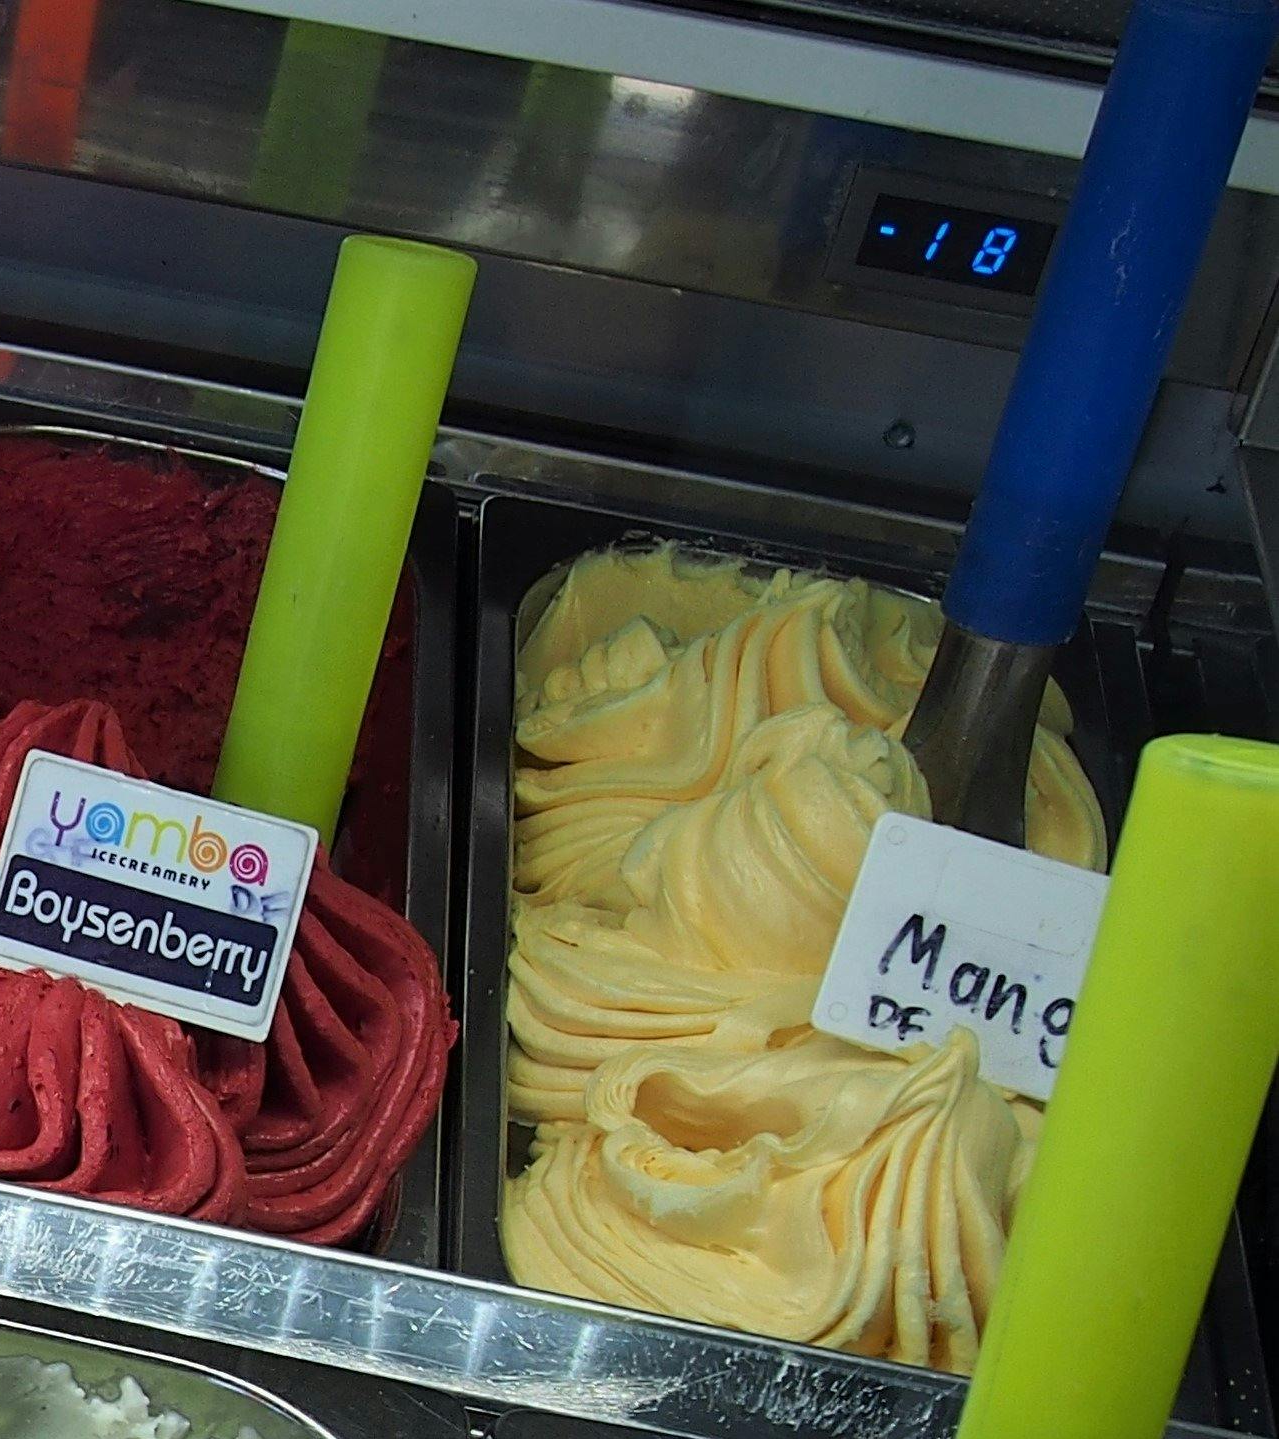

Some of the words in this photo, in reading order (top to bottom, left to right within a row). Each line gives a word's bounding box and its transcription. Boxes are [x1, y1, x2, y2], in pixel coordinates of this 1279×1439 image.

[880, 222, 1017, 275] -18
[49, 791, 269, 887] yamba
[91, 848, 211, 891] ICECREAMERY
[4, 869, 268, 993] Boysenberry
[868, 995, 932, 1041] DF
[878, 913, 1077, 1069] Mang
